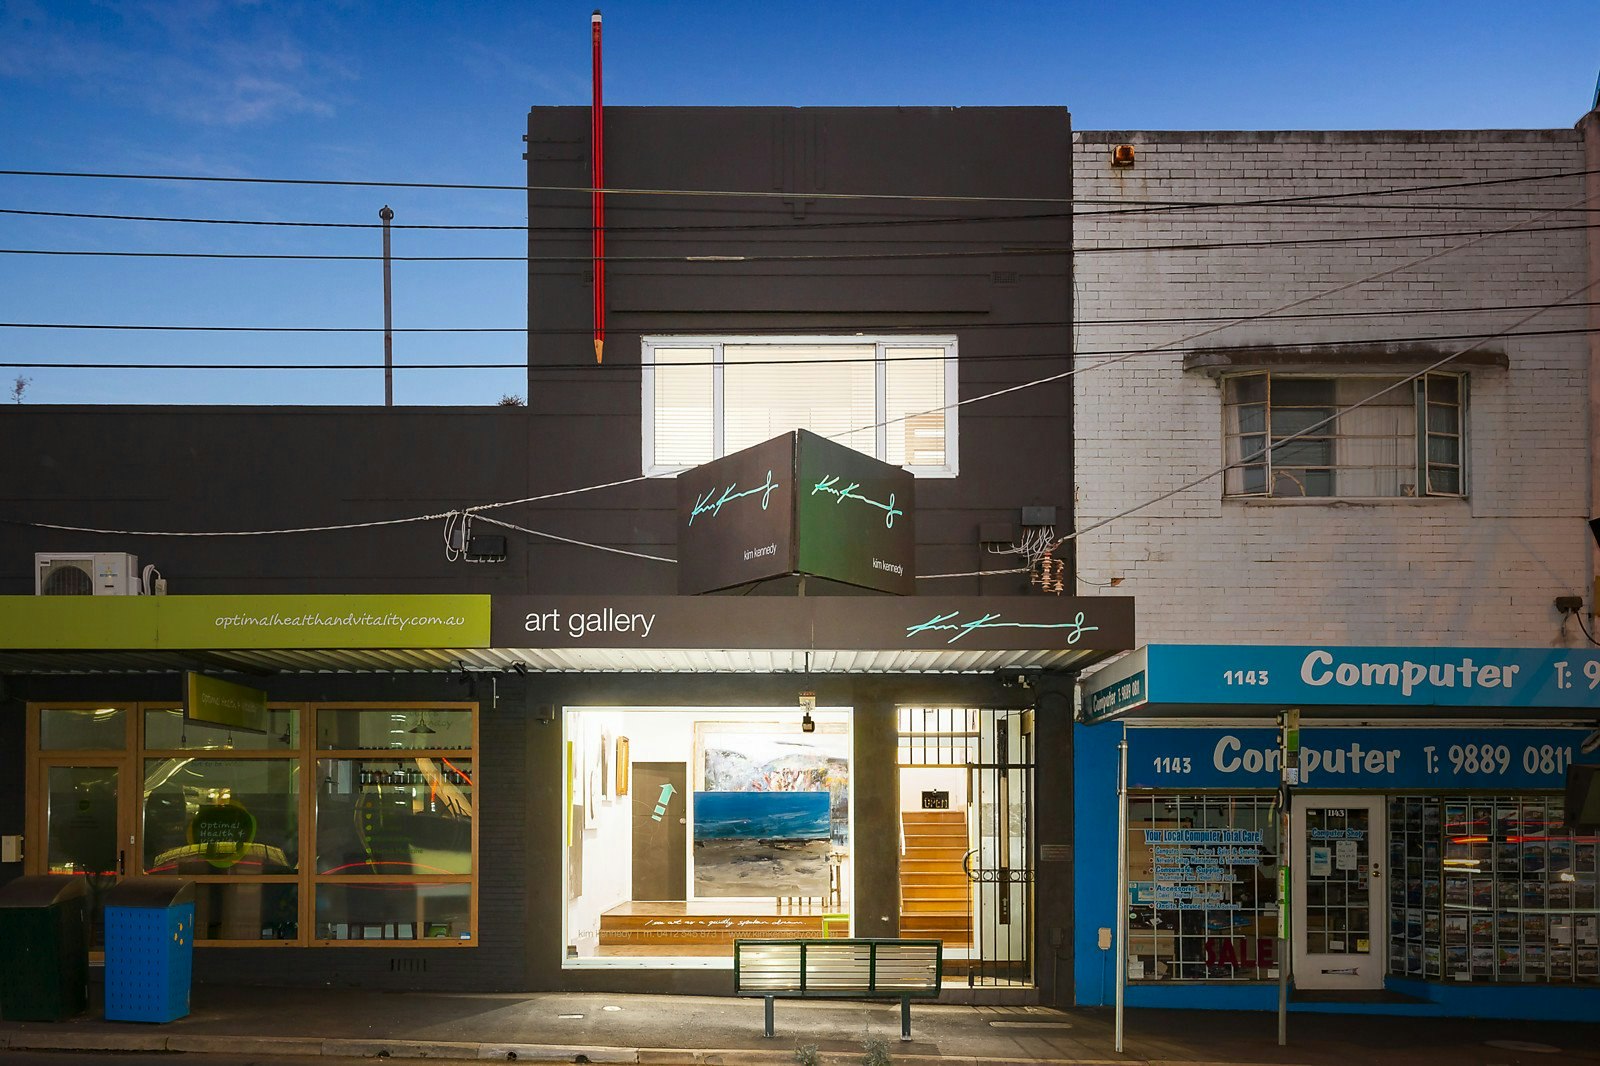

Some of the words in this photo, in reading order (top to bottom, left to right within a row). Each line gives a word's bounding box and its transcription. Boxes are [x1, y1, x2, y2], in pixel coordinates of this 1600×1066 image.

[743, 548, 754, 561] kim
[754, 542, 777, 559] kennedy
[872, 557, 883, 569] kim
[882, 559, 904, 576] kennedy
[215, 612, 465, 631] optimalhealthandvitality.com.au
[524, 608, 561, 632] art
[568, 607, 656, 638] gallery
[1223, 670, 1269, 686] 1143
[1300, 649, 1520, 697] Computer
[1554, 661, 1572, 689] T:
[1093, 692, 1116, 714] Computer
[1152, 756, 1192, 774] 1143
[1213, 735, 1401, 784] Computer
[1423, 746, 1440, 774] T:
[1448, 743, 1511, 775] 9889
[1523, 744, 1572, 775] 0811
[1328, 809, 1345, 817] 1143
[200, 821, 240, 830] Optimal
[200, 829, 234, 838] Health
[1144, 829, 1161, 842] Your
[1163, 829, 1184, 842] Local
[1184, 829, 1221, 842] Computer
[1221, 829, 1242, 842] Total
[1311, 827, 1344, 838] Computer
[1345, 827, 1364, 838] Shop
[1155, 884, 1199, 892] Accessories
[1179, 902, 1201, 910] Service
[708, 918, 734, 928] quietly
[578, 930, 593, 938] kim
[1205, 937, 1273, 968] SALE
